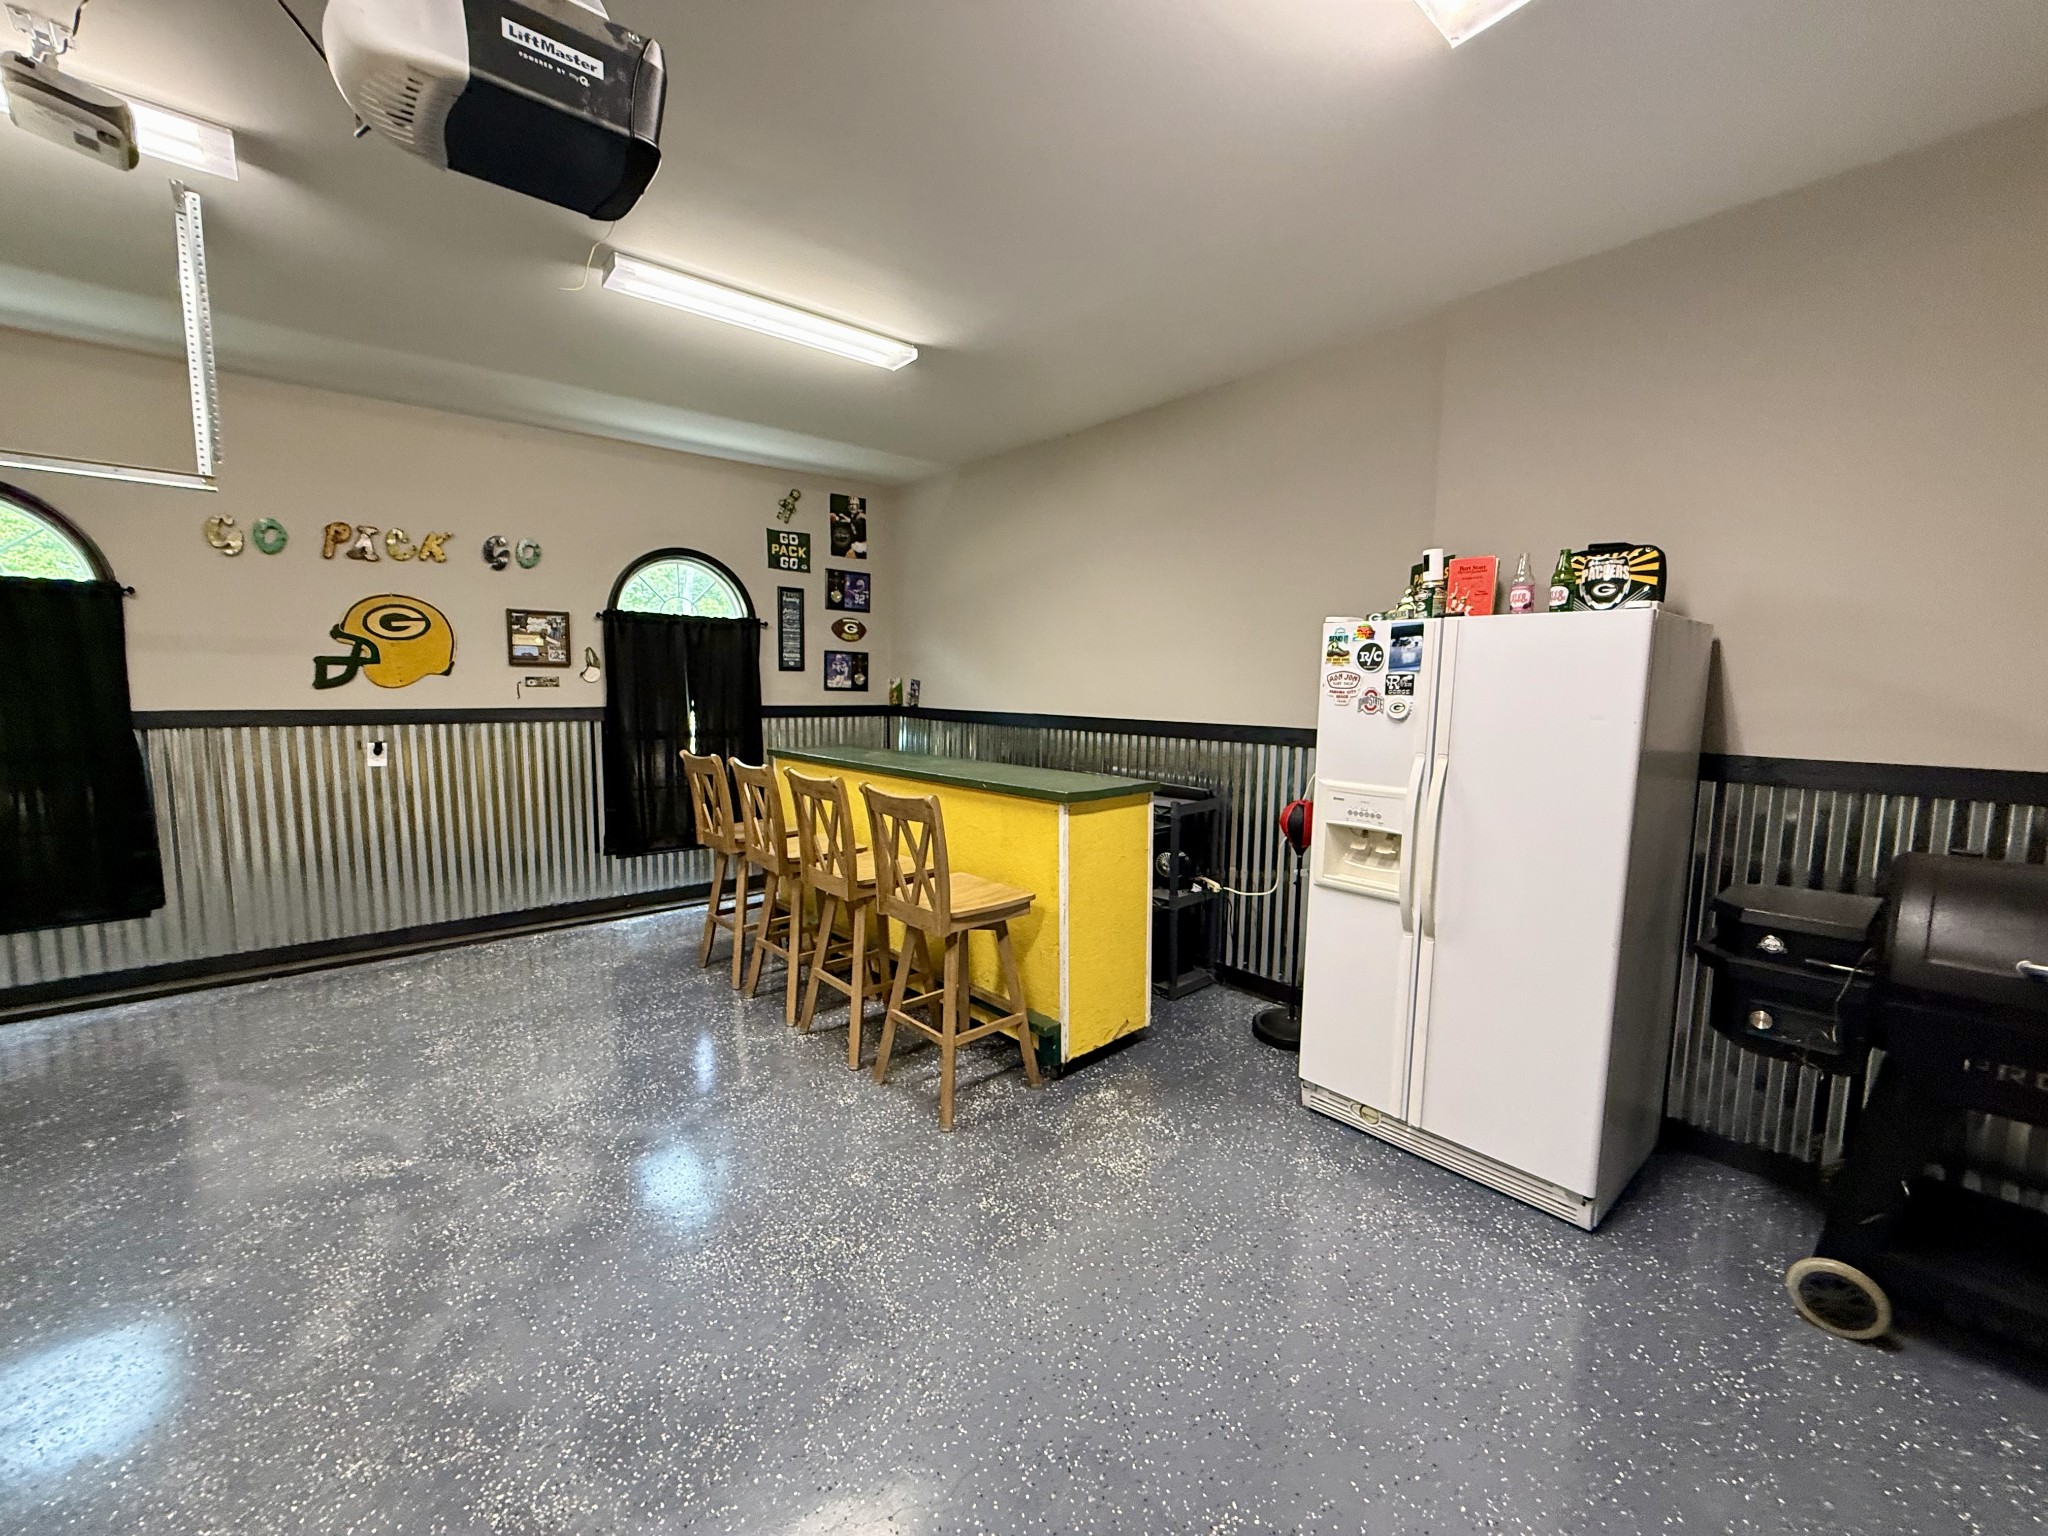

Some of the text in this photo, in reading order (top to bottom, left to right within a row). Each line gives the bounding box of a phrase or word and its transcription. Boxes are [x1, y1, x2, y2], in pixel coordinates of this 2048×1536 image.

[508, 24, 598, 73] LiftMaster
[205, 513, 543, 572] GO PACK GO
[780, 533, 799, 545] GO
[771, 543, 807, 559] PACK
[780, 556, 799, 570] GO
[1581, 564, 1630, 584] PACKERS
